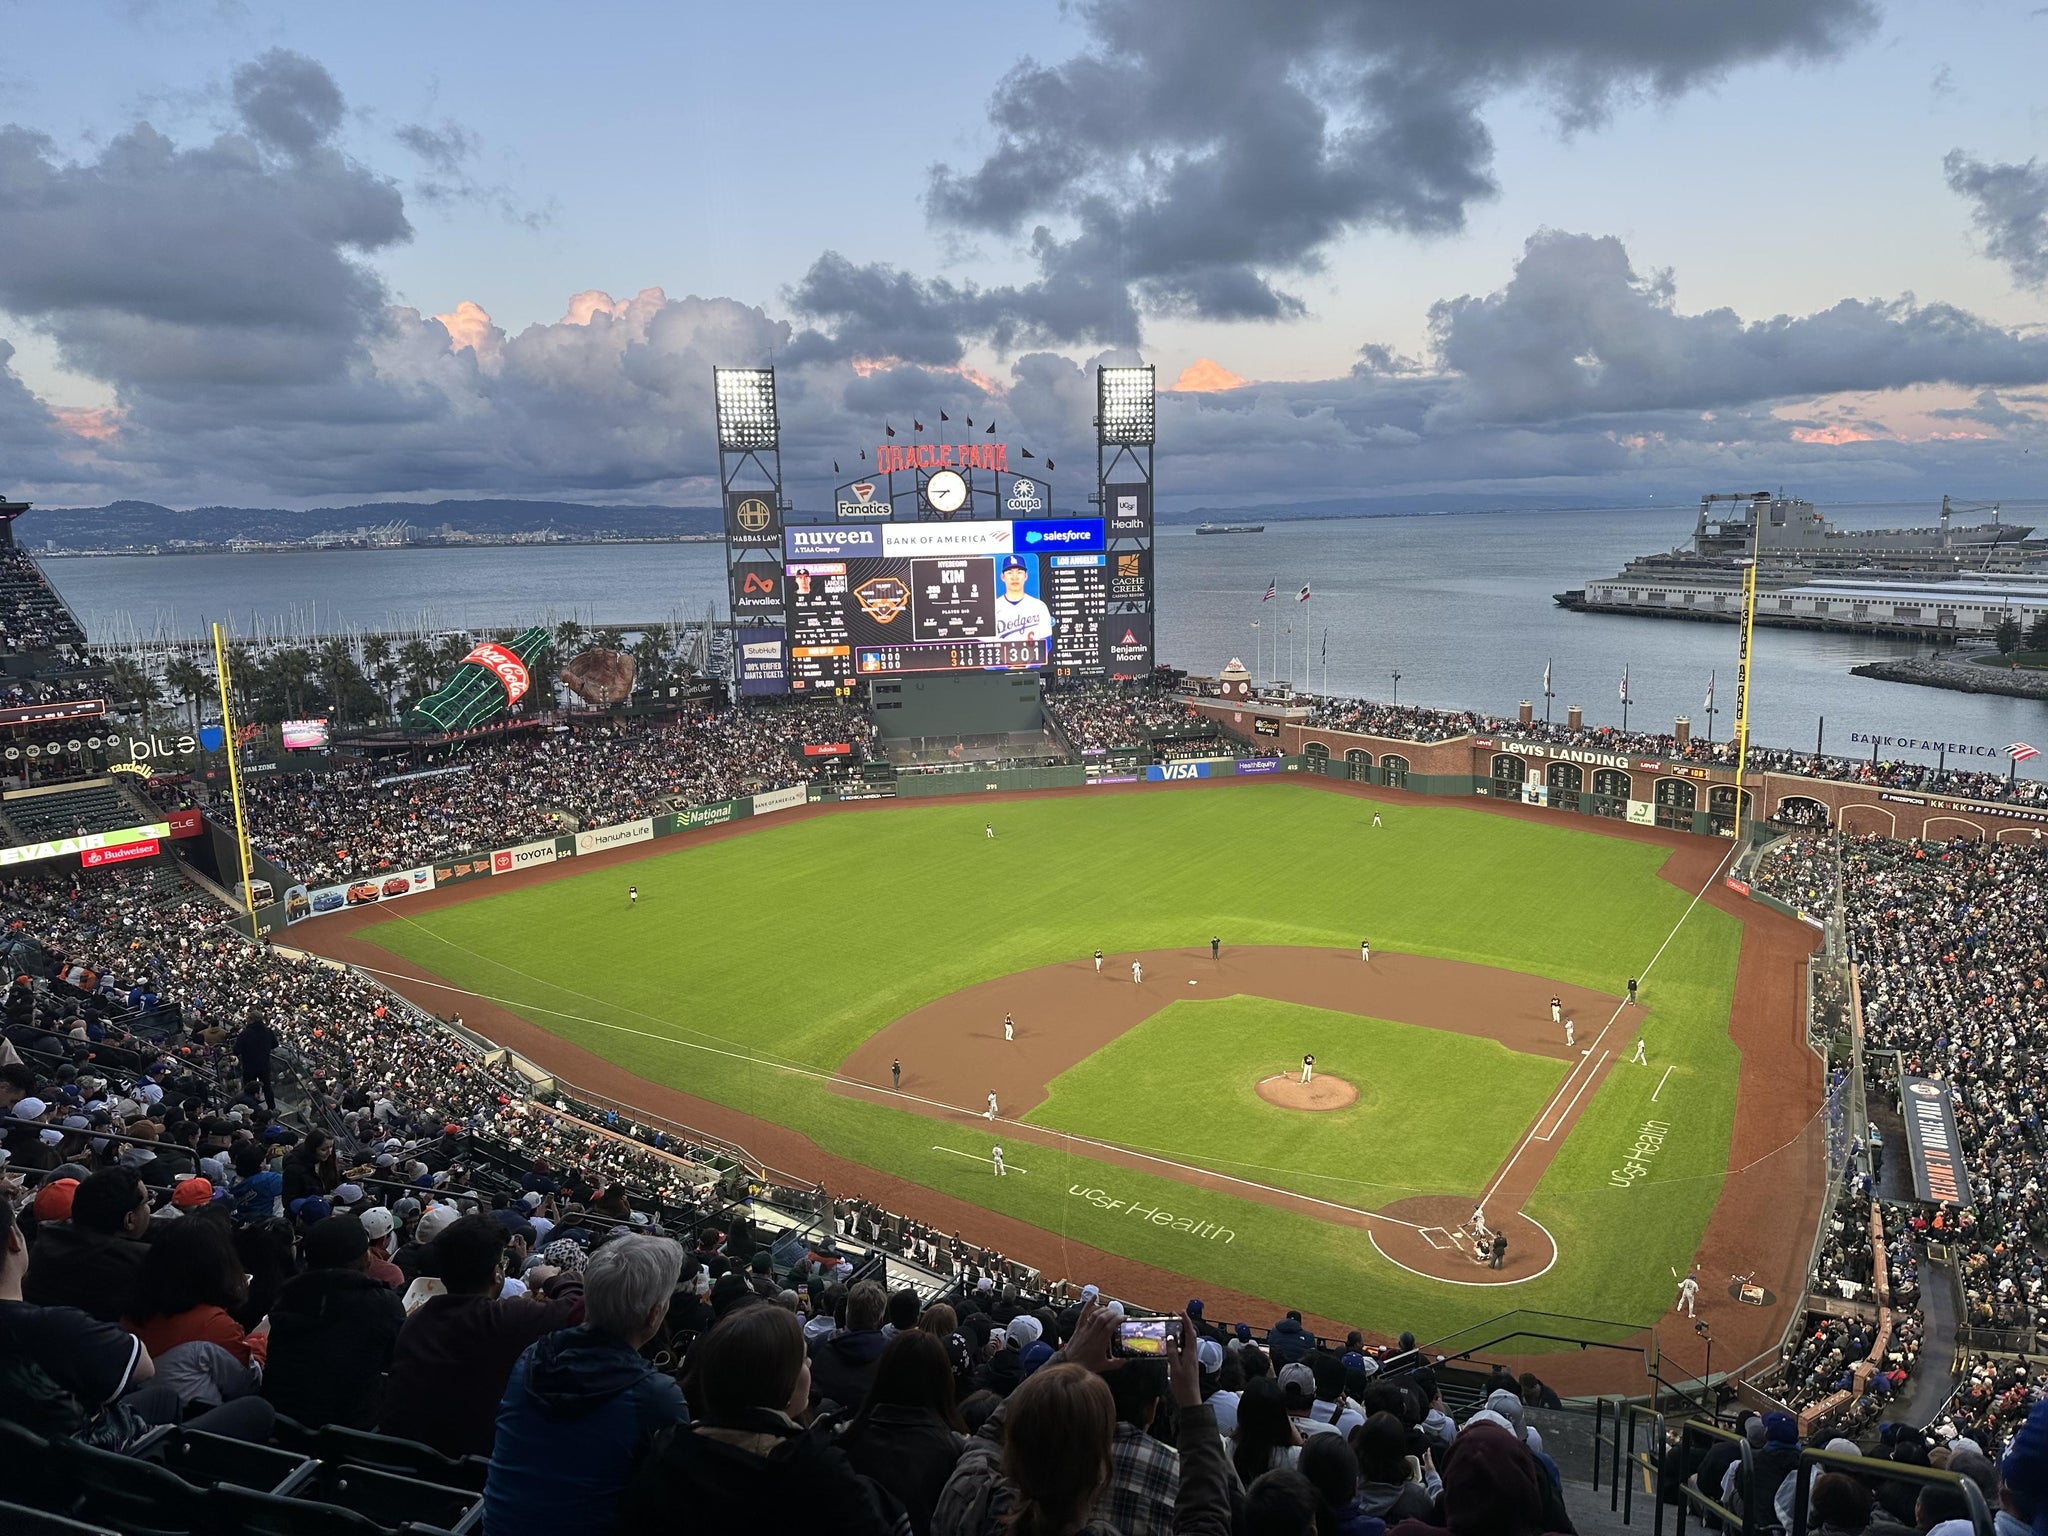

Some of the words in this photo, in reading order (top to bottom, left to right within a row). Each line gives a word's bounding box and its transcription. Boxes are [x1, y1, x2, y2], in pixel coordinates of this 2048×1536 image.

[877, 445, 951, 474] ORACLE
[958, 444, 1008, 473] PARK
[840, 502, 890, 514] Fanatics
[1009, 498, 1040, 510] coupa
[1120, 502, 1136, 510] UCSF
[1112, 519, 1144, 528] Health
[794, 530, 874, 544] nuveen
[887, 536, 917, 545] BANK
[920, 536, 934, 544] OF
[937, 535, 986, 544] AMERICA
[1043, 530, 1091, 542] salesforce
[1057, 557, 1070, 566] LOS
[942, 570, 964, 584] KIM
[1112, 577, 1145, 586] CACHE
[738, 598, 780, 606] Airwallex
[996, 614, 1040, 636] Dodgers
[1010, 649, 1018, 662] 3
[1020, 648, 1029, 662] 0
[1034, 648, 1038, 660] 1
[1110, 644, 1148, 654] Benjamin
[1116, 654, 1142, 662] Moore
[470, 644, 528, 698] Coca-Cola
[746, 663, 760, 671] 100%
[760, 662, 782, 670] VERIFIED
[880, 661, 886, 669] 3
[744, 672, 762, 680] GIANTS
[764, 671, 784, 679] TICKETS
[1058, 668, 1070, 676] 0:13
[1738, 665, 1744, 682] IZ
[129, 735, 196, 760] blue
[1851, 733, 1892, 746] BANK
[1897, 738, 1916, 748] OF
[1922, 740, 1996, 758] AMERICA
[1550, 748, 1628, 768] LANDING
[244, 764, 258, 774] FAN
[258, 763, 276, 772] ZONE
[1240, 761, 1276, 769] HealthEquity
[1159, 764, 1198, 780] VISA
[774, 797, 796, 806] AMERICA
[1889, 796, 1924, 805] PRIZEPICKS
[690, 804, 732, 824] National
[714, 816, 730, 824] Rental
[170, 819, 194, 830] CLE
[595, 830, 632, 845] Hanwha
[632, 826, 650, 836] Life
[1720, 828, 1735, 837] 309
[1, 843, 58, 864] EVA
[57, 835, 105, 853] AIR
[104, 844, 154, 860] Budweiser
[515, 848, 554, 862] TOYOTA
[558, 850, 572, 858] 354
[1728, 880, 1746, 892] ORACLE
[258, 924, 271, 936] 339
[1916, 1100, 1942, 1120] PARK
[1918, 1120, 1949, 1149] ORACLE
[1622, 1120, 1671, 1162] Health
[1924, 1150, 1952, 1160] TO
[1608, 1161, 1648, 1188] UCSF
[1926, 1162, 1960, 1202] WELCOME
[1068, 1184, 1126, 1210] UCSF
[1125, 1202, 1236, 1244] Health
